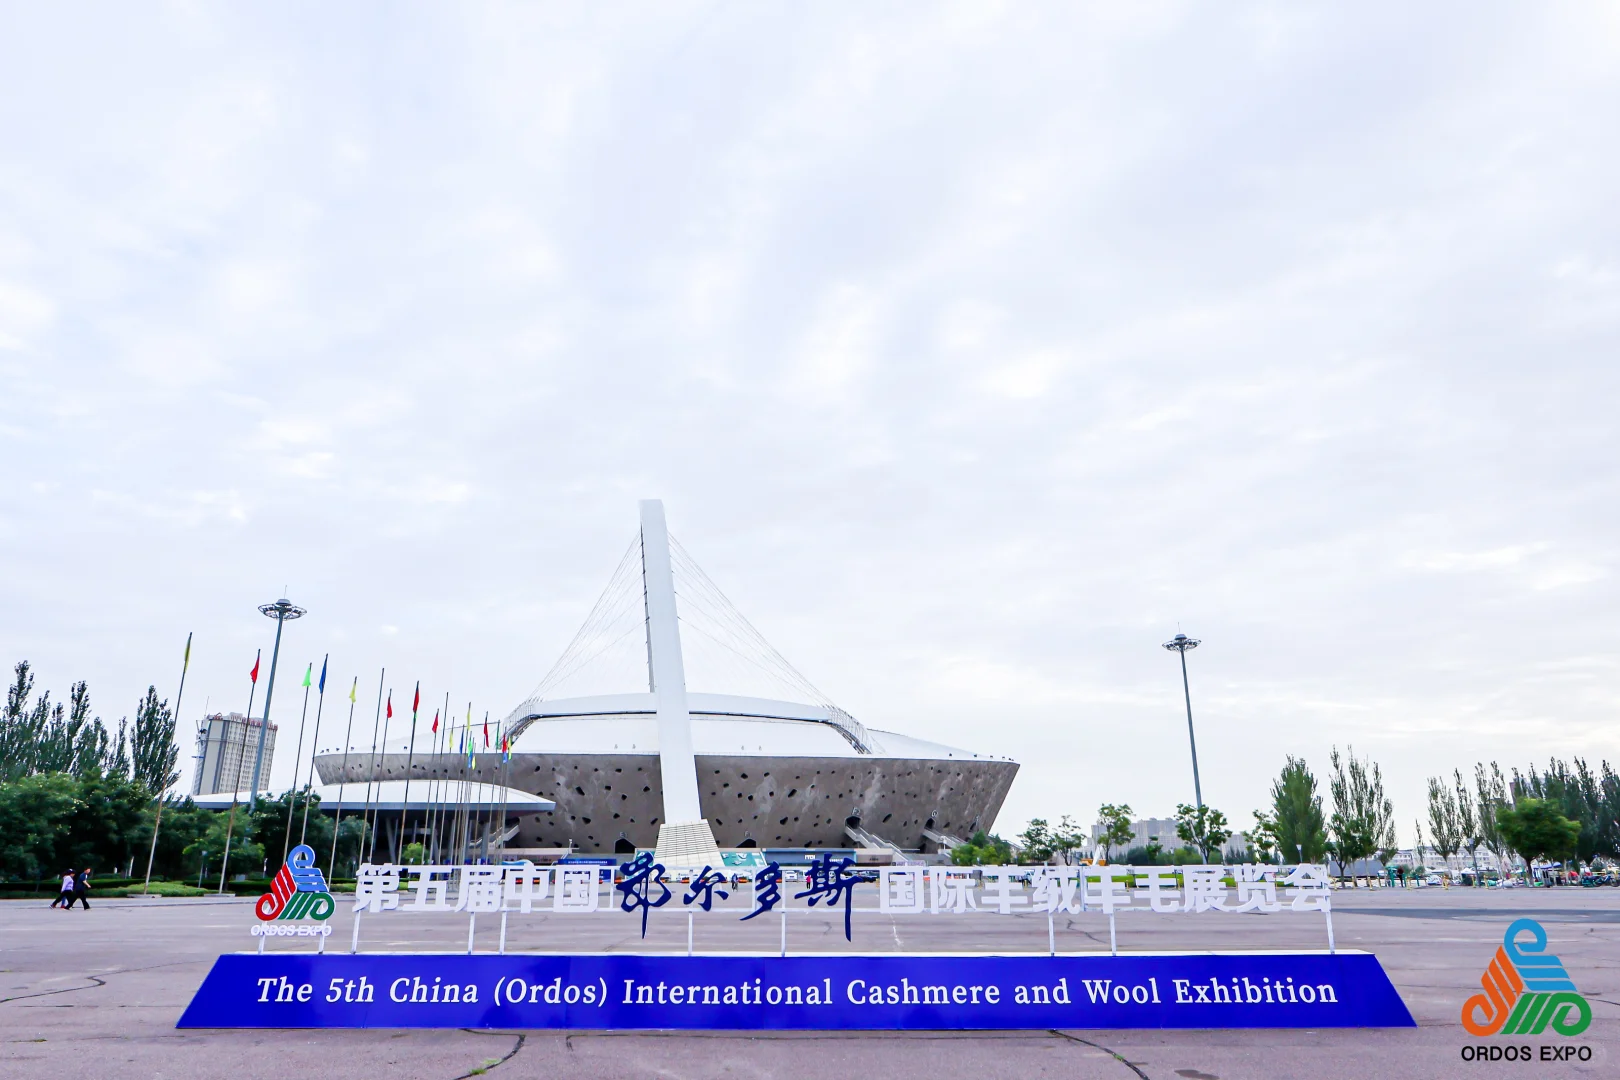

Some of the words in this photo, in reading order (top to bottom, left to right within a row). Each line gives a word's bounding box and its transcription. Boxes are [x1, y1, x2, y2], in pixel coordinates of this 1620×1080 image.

[250, 924, 295, 936] ORDOS
[297, 924, 332, 937] EXPO
[258, 976, 312, 1003] The
[326, 976, 373, 1003] 5th
[390, 976, 478, 1003] China
[495, 976, 606, 1008] (Ordos)
[623, 977, 832, 1005] International
[847, 977, 999, 1005] Cashmere
[1015, 977, 1071, 1005] and
[1082, 977, 1161, 1004] Wool
[1176, 977, 1338, 1004] Exhibition
